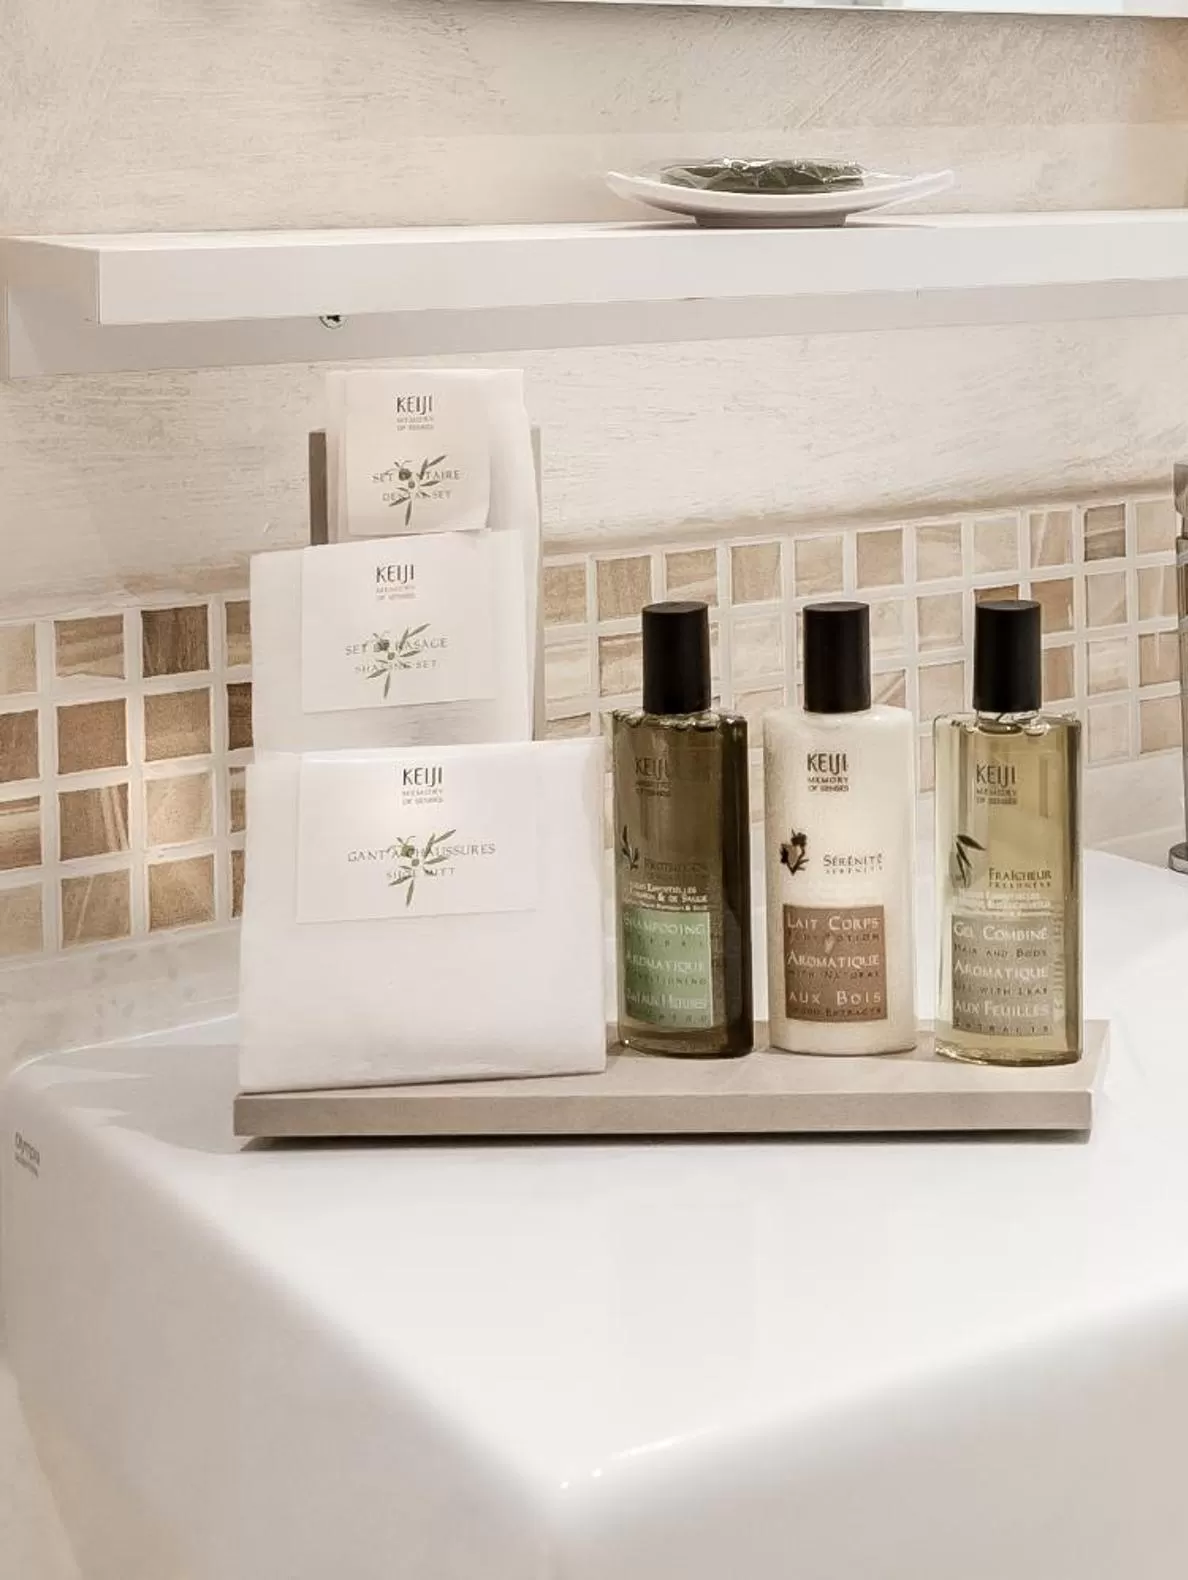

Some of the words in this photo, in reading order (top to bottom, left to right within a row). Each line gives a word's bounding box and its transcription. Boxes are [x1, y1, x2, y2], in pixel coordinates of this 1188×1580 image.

[396, 395, 432, 415] KEIJI
[376, 564, 414, 584] KEIJI
[345, 643, 367, 656] SET
[807, 753, 847, 775] KEIJI
[402, 767, 442, 787] KEIJI
[976, 764, 1016, 788] KEIJI
[347, 849, 387, 862] GANT
[787, 911, 817, 929] LAIT
[828, 915, 880, 931] CORPS
[788, 950, 880, 969] AROMATIQUE
[954, 959, 1049, 981] AROMATIQUE
[789, 991, 820, 1005] AUX
[836, 990, 881, 1006] BOIS
